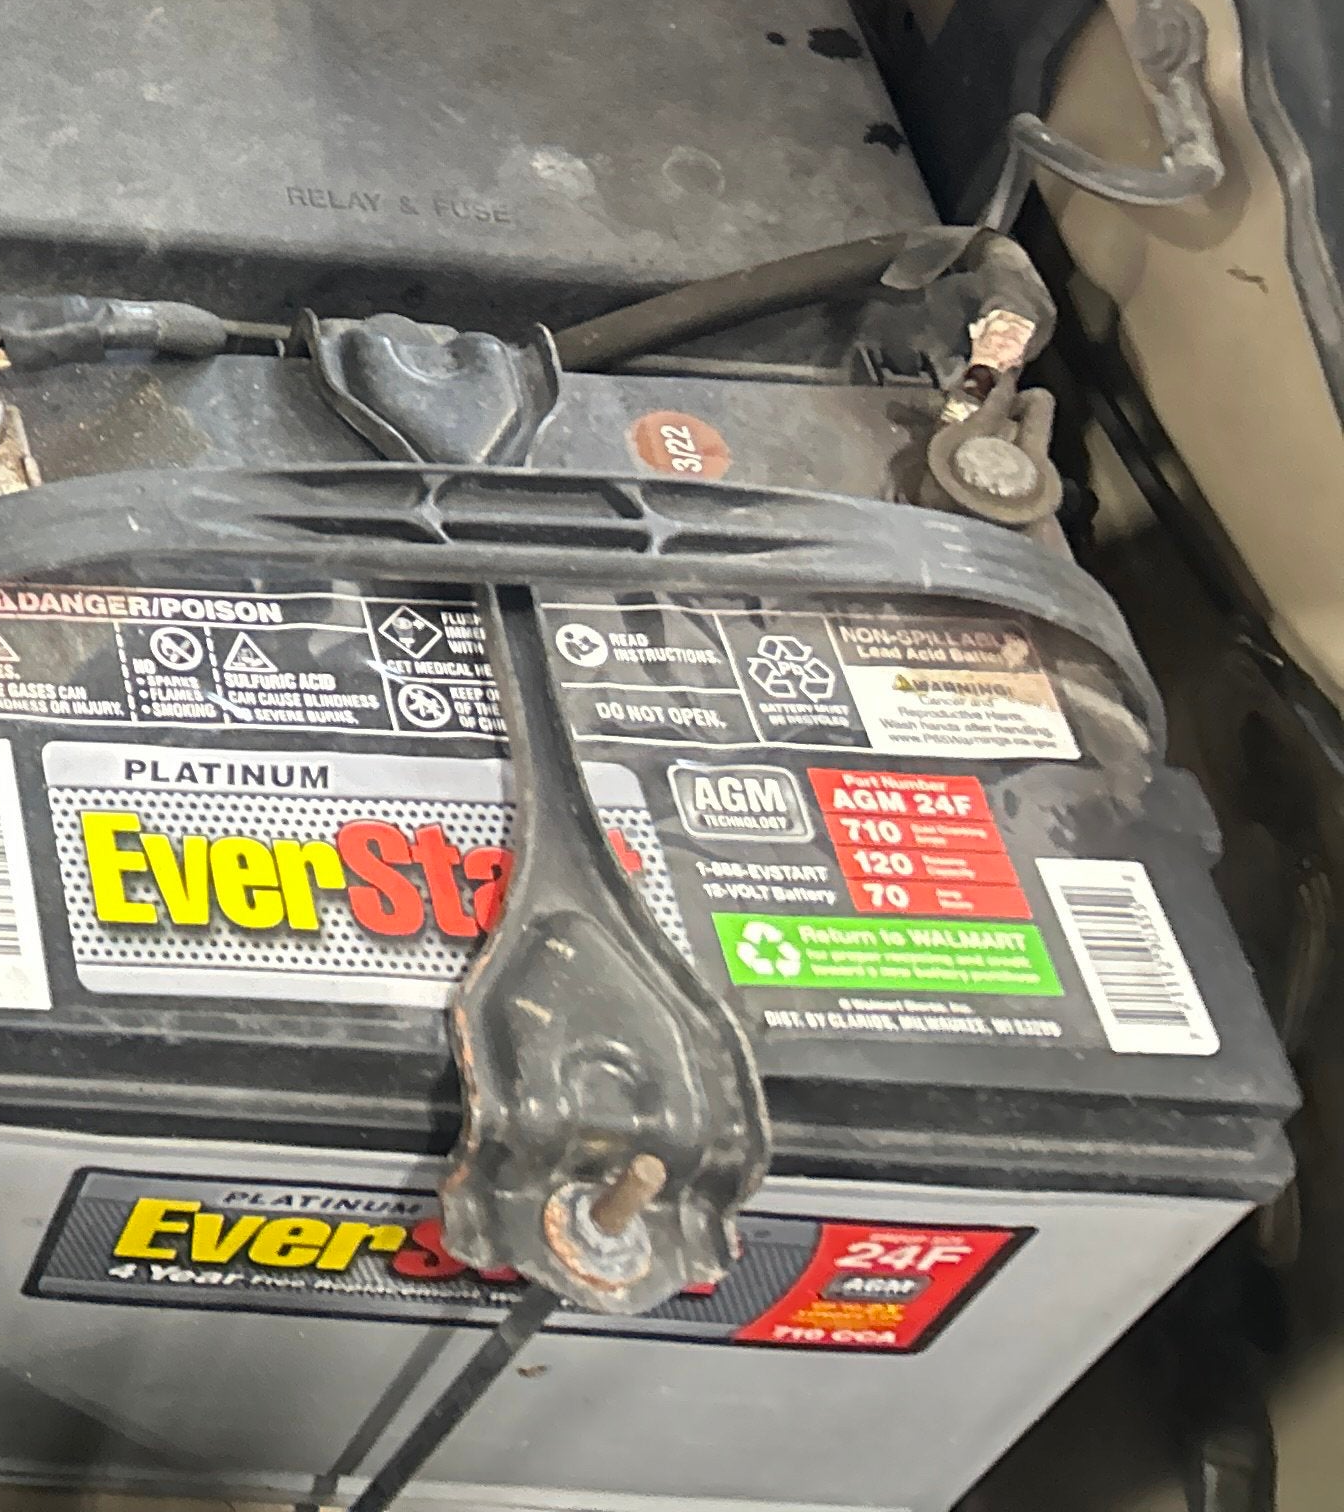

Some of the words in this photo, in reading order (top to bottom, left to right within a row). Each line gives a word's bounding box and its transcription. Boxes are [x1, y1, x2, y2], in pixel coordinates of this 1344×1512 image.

[286, 186, 380, 212] RELAY
[400, 195, 419, 215] &
[432, 197, 512, 223] FUSE
[660, 425, 703, 473] 3/22
[17, 592, 283, 623] DANGER/POISON
[609, 633, 648, 647] READ
[614, 648, 722, 665] INSTRUCTIONS.
[857, 646, 902, 660] Lead
[906, 648, 947, 662] Acid
[133, 658, 156, 675] NO
[414, 661, 474, 677] MEDICAL
[7, 682, 56, 700] GASES
[58, 686, 88, 701] CAN
[223, 673, 297, 690] SULFURIC
[299, 674, 336, 691] ACID
[150, 688, 204, 702] FLAMES
[228, 690, 256, 706] CAN
[258, 692, 301, 708] CAUSE
[303, 693, 379, 710] BLINDNESS
[152, 703, 217, 719] SMOKING
[596, 702, 624, 721] DO
[626, 704, 665, 723] NOT
[668, 707, 727, 728] OPEN.
[124, 759, 330, 789] PLATINUM
[842, 774, 888, 790] Part
[889, 776, 948, 794] Number
[693, 776, 788, 814] AGM
[832, 789, 906, 815] AGM
[912, 792, 973, 817] 24F
[704, 816, 787, 831] TECHNOLOGY
[840, 817, 902, 845] 710
[79, 809, 517, 939] EverSta
[853, 850, 912, 877] 120
[775, 885, 837, 906] Battery
[864, 882, 909, 909] 70
[798, 925, 877, 947] Return
[880, 928, 907, 947] to
[907, 928, 1026, 952] WALMART
[222, 1190, 421, 1215] PLATINUM
[833, 1241, 973, 1271] 24F
[108, 1264, 137, 1280] 4
[149, 1265, 246, 1285] Year
[841, 1277, 917, 1294] AGM
[772, 1325, 825, 1341] 710
